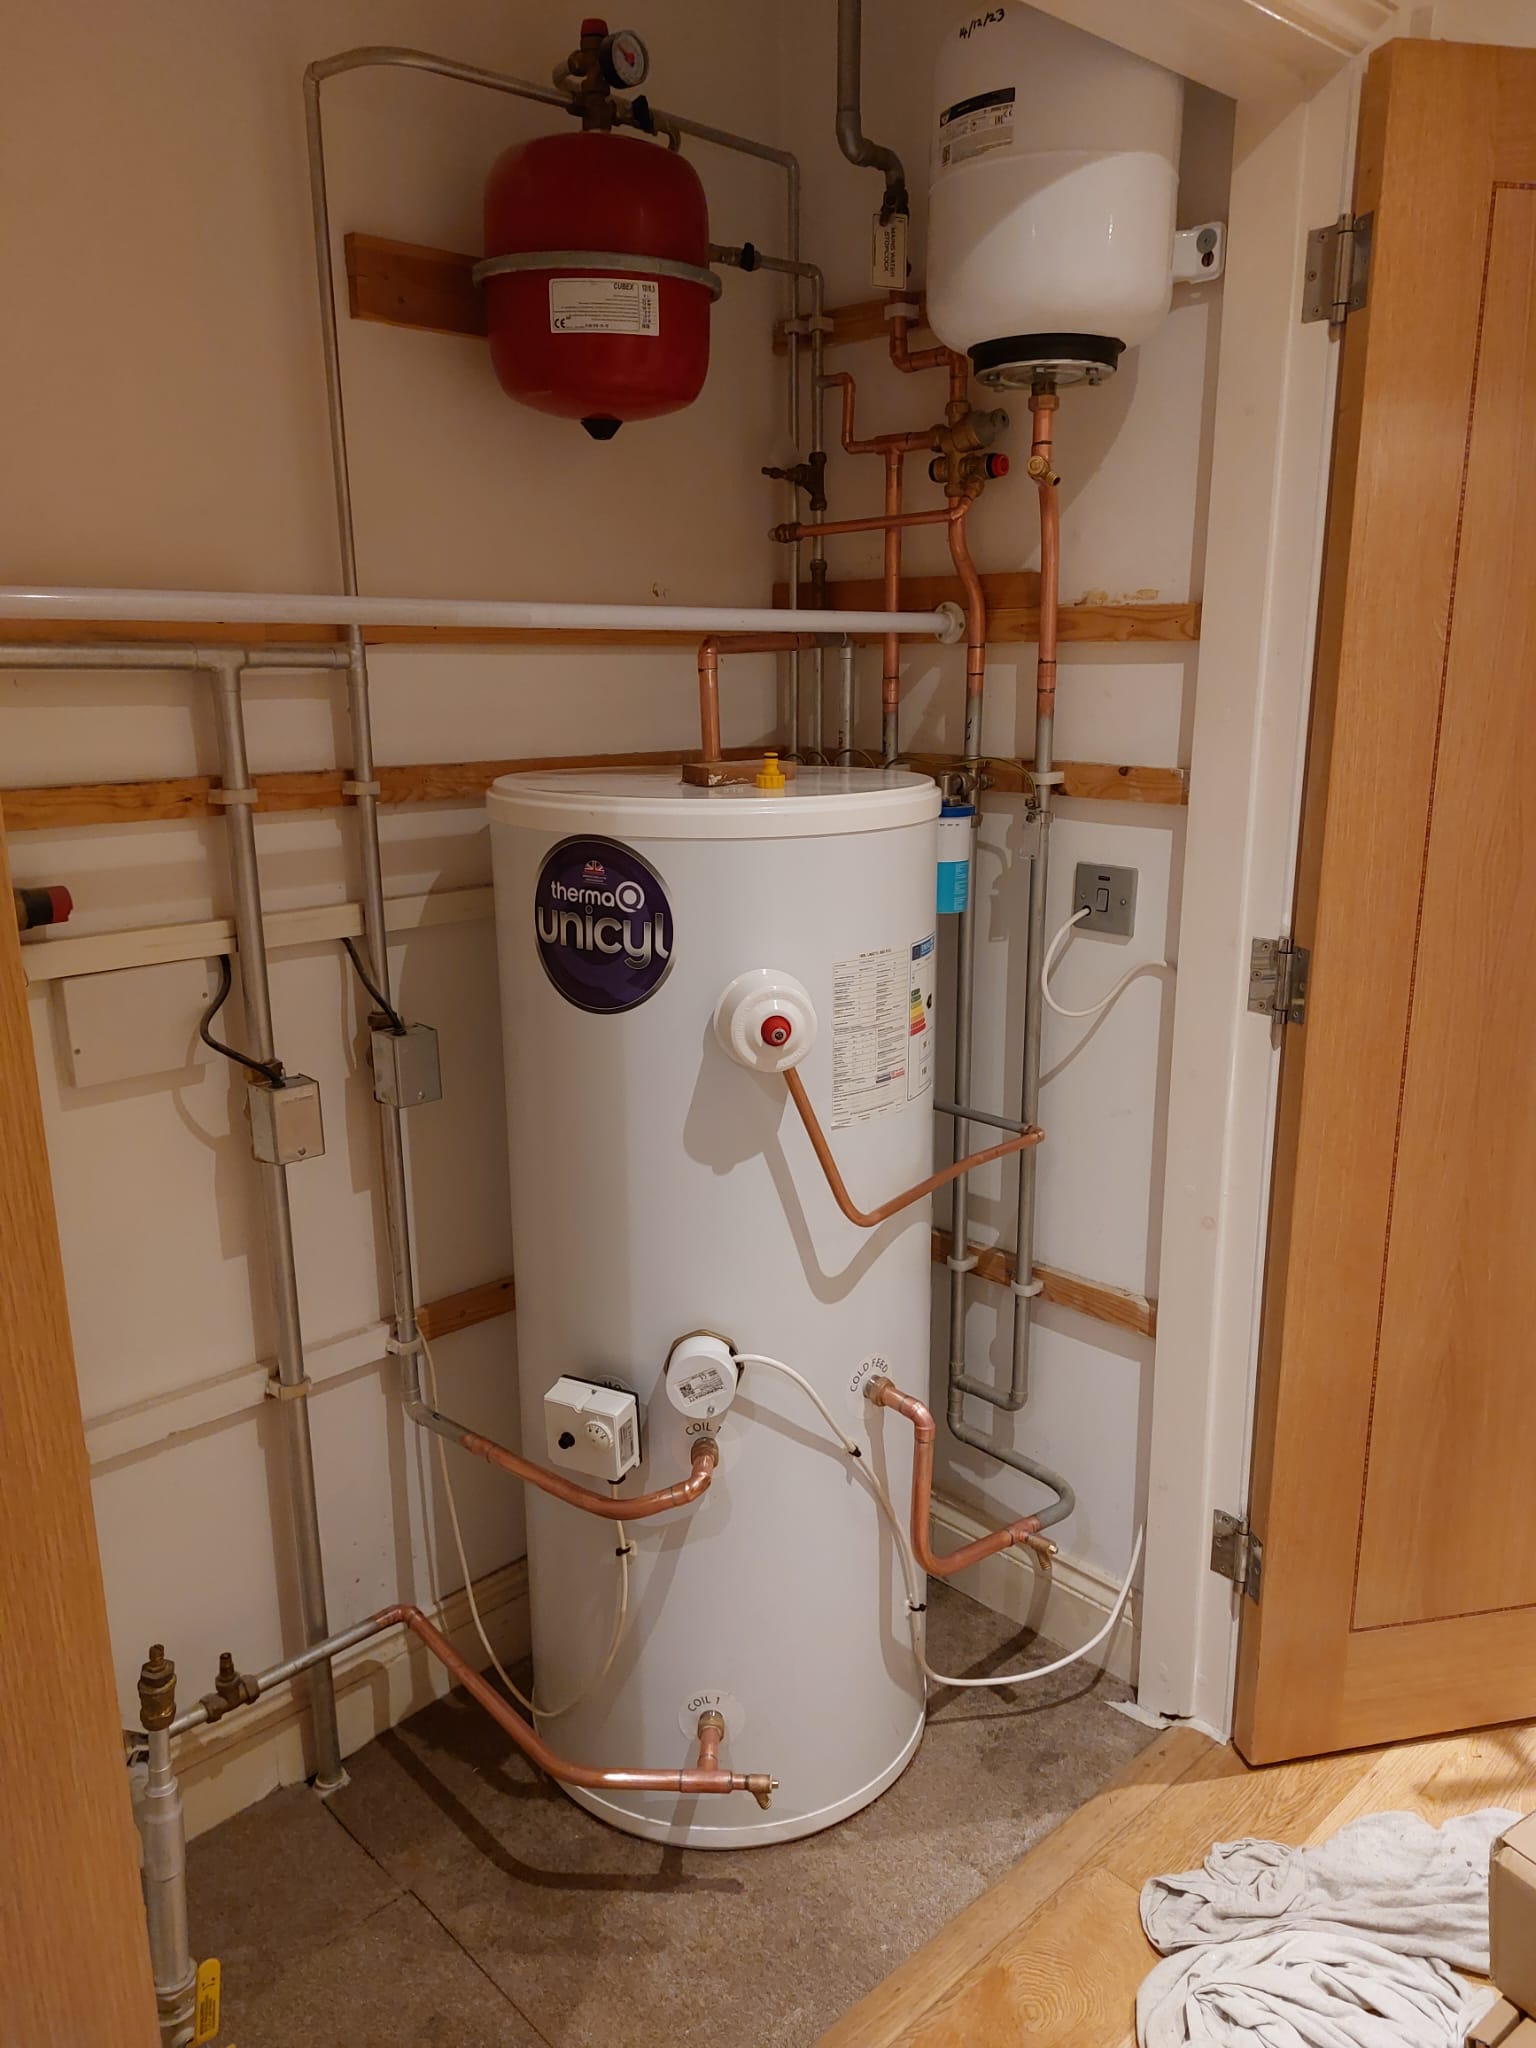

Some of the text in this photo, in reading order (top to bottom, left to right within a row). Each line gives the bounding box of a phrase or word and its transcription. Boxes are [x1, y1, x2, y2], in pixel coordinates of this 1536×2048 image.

[613, 282, 634, 291] CUBEX
[537, 905, 669, 970] unicyl
[850, 1357, 888, 1392] COLD FEED
[685, 1421, 712, 1435] COIL
[687, 1695, 720, 1711] COIL 1
